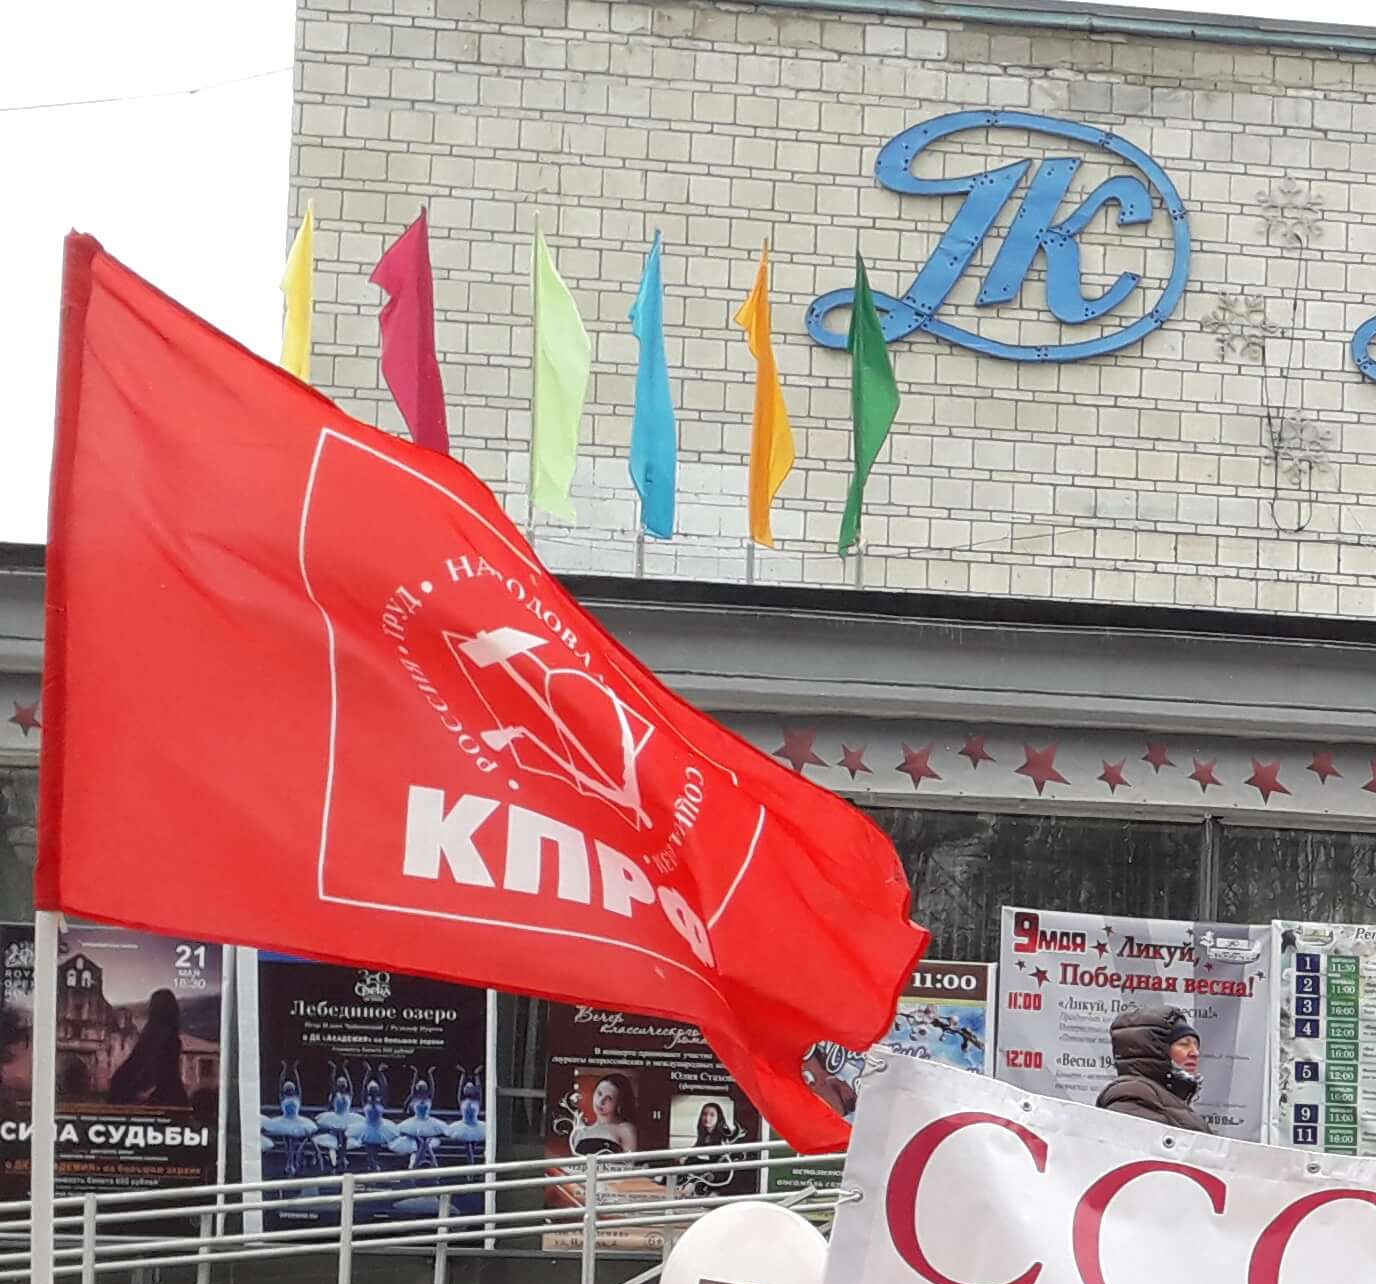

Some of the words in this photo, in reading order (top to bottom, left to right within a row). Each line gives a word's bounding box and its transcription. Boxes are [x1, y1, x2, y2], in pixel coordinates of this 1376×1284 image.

[402, 784, 717, 969] КПРФ
[175, 945, 206, 968] 21
[1116, 935, 1201, 968] Ликуй,
[1303, 957, 1312, 970] 1
[911, 971, 978, 990] 11:00
[1059, 962, 1178, 994] Победная
[1183, 975, 1256, 998] весна!
[1303, 977, 1313, 992] 2
[1007, 991, 1042, 1011] 11:00
[1303, 999, 1313, 1014] 3
[290, 1000, 398, 1020] Лебединое
[402, 1005, 457, 1024] озеро
[1302, 1021, 1312, 1035] 4
[1006, 1050, 1042, 1069] 12:00
[1301, 1065, 1312, 1080] 5
[1300, 1106, 1311, 1121] 9
[1, 1120, 79, 1143] СИА
[88, 1123, 209, 1148] СУДЬБЫ
[1296, 1128, 1313, 1142] 11
